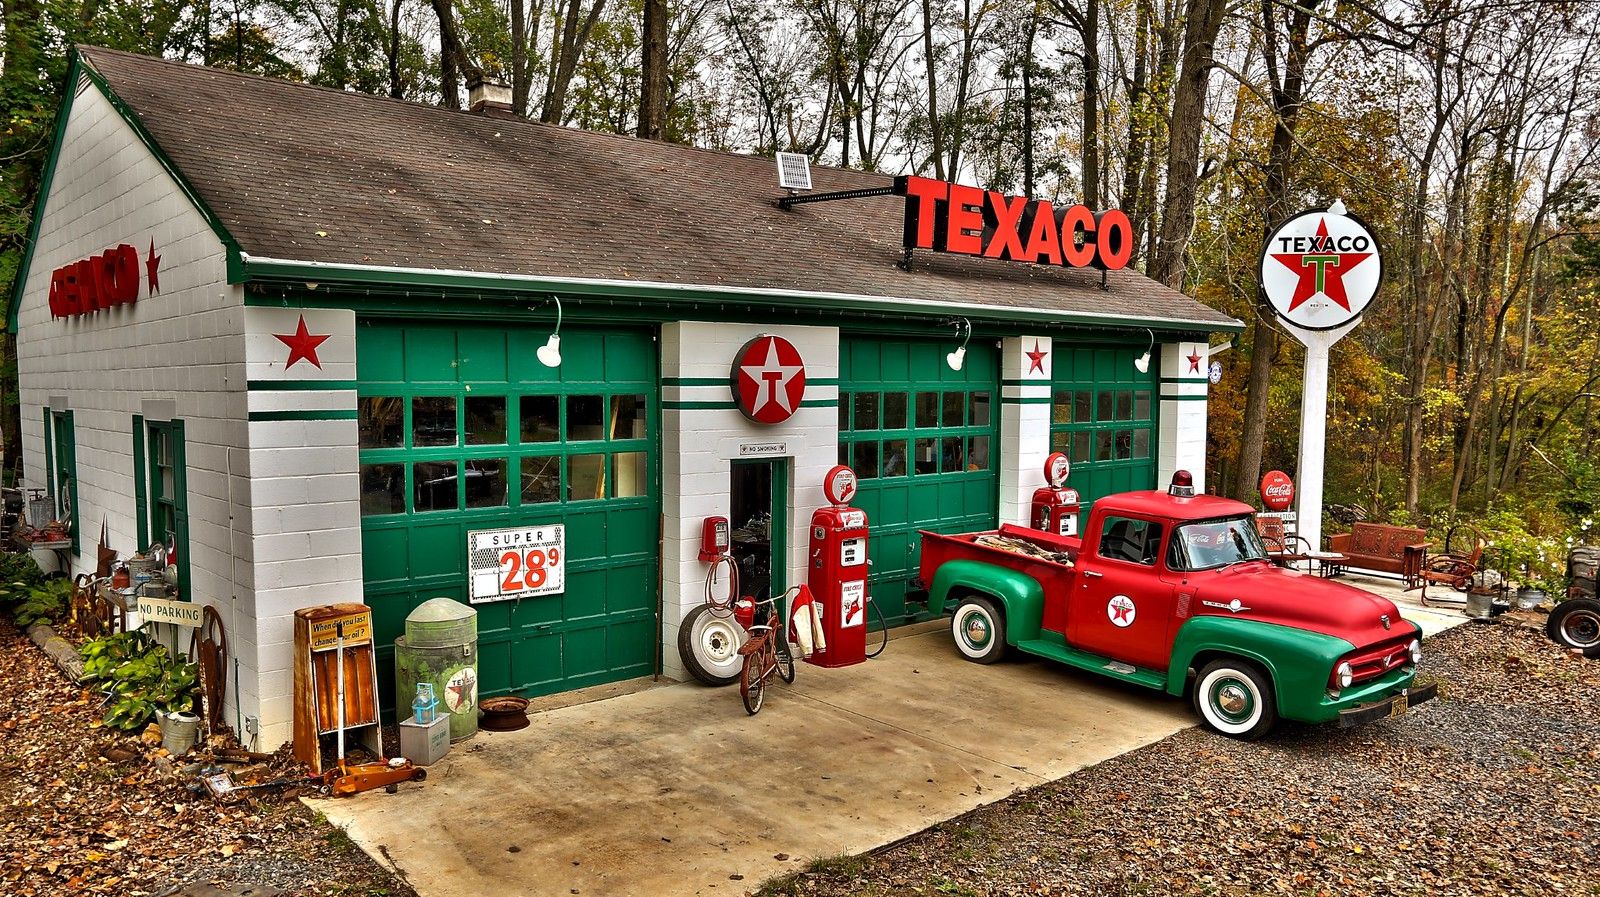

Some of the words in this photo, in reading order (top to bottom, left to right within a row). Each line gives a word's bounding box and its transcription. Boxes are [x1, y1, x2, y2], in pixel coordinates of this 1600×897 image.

[906, 175, 1133, 270] TEXACO
[1278, 235, 1370, 253] TEXACO
[1302, 255, 1340, 293] T
[493, 531, 543, 545] SUPER
[500, 549, 547, 591] 28
[548, 547, 559, 567] 9
[140, 604, 152, 615] NO
[157, 605, 199, 620] PARKING
[313, 622, 332, 632] When
[314, 637, 337, 647] change
